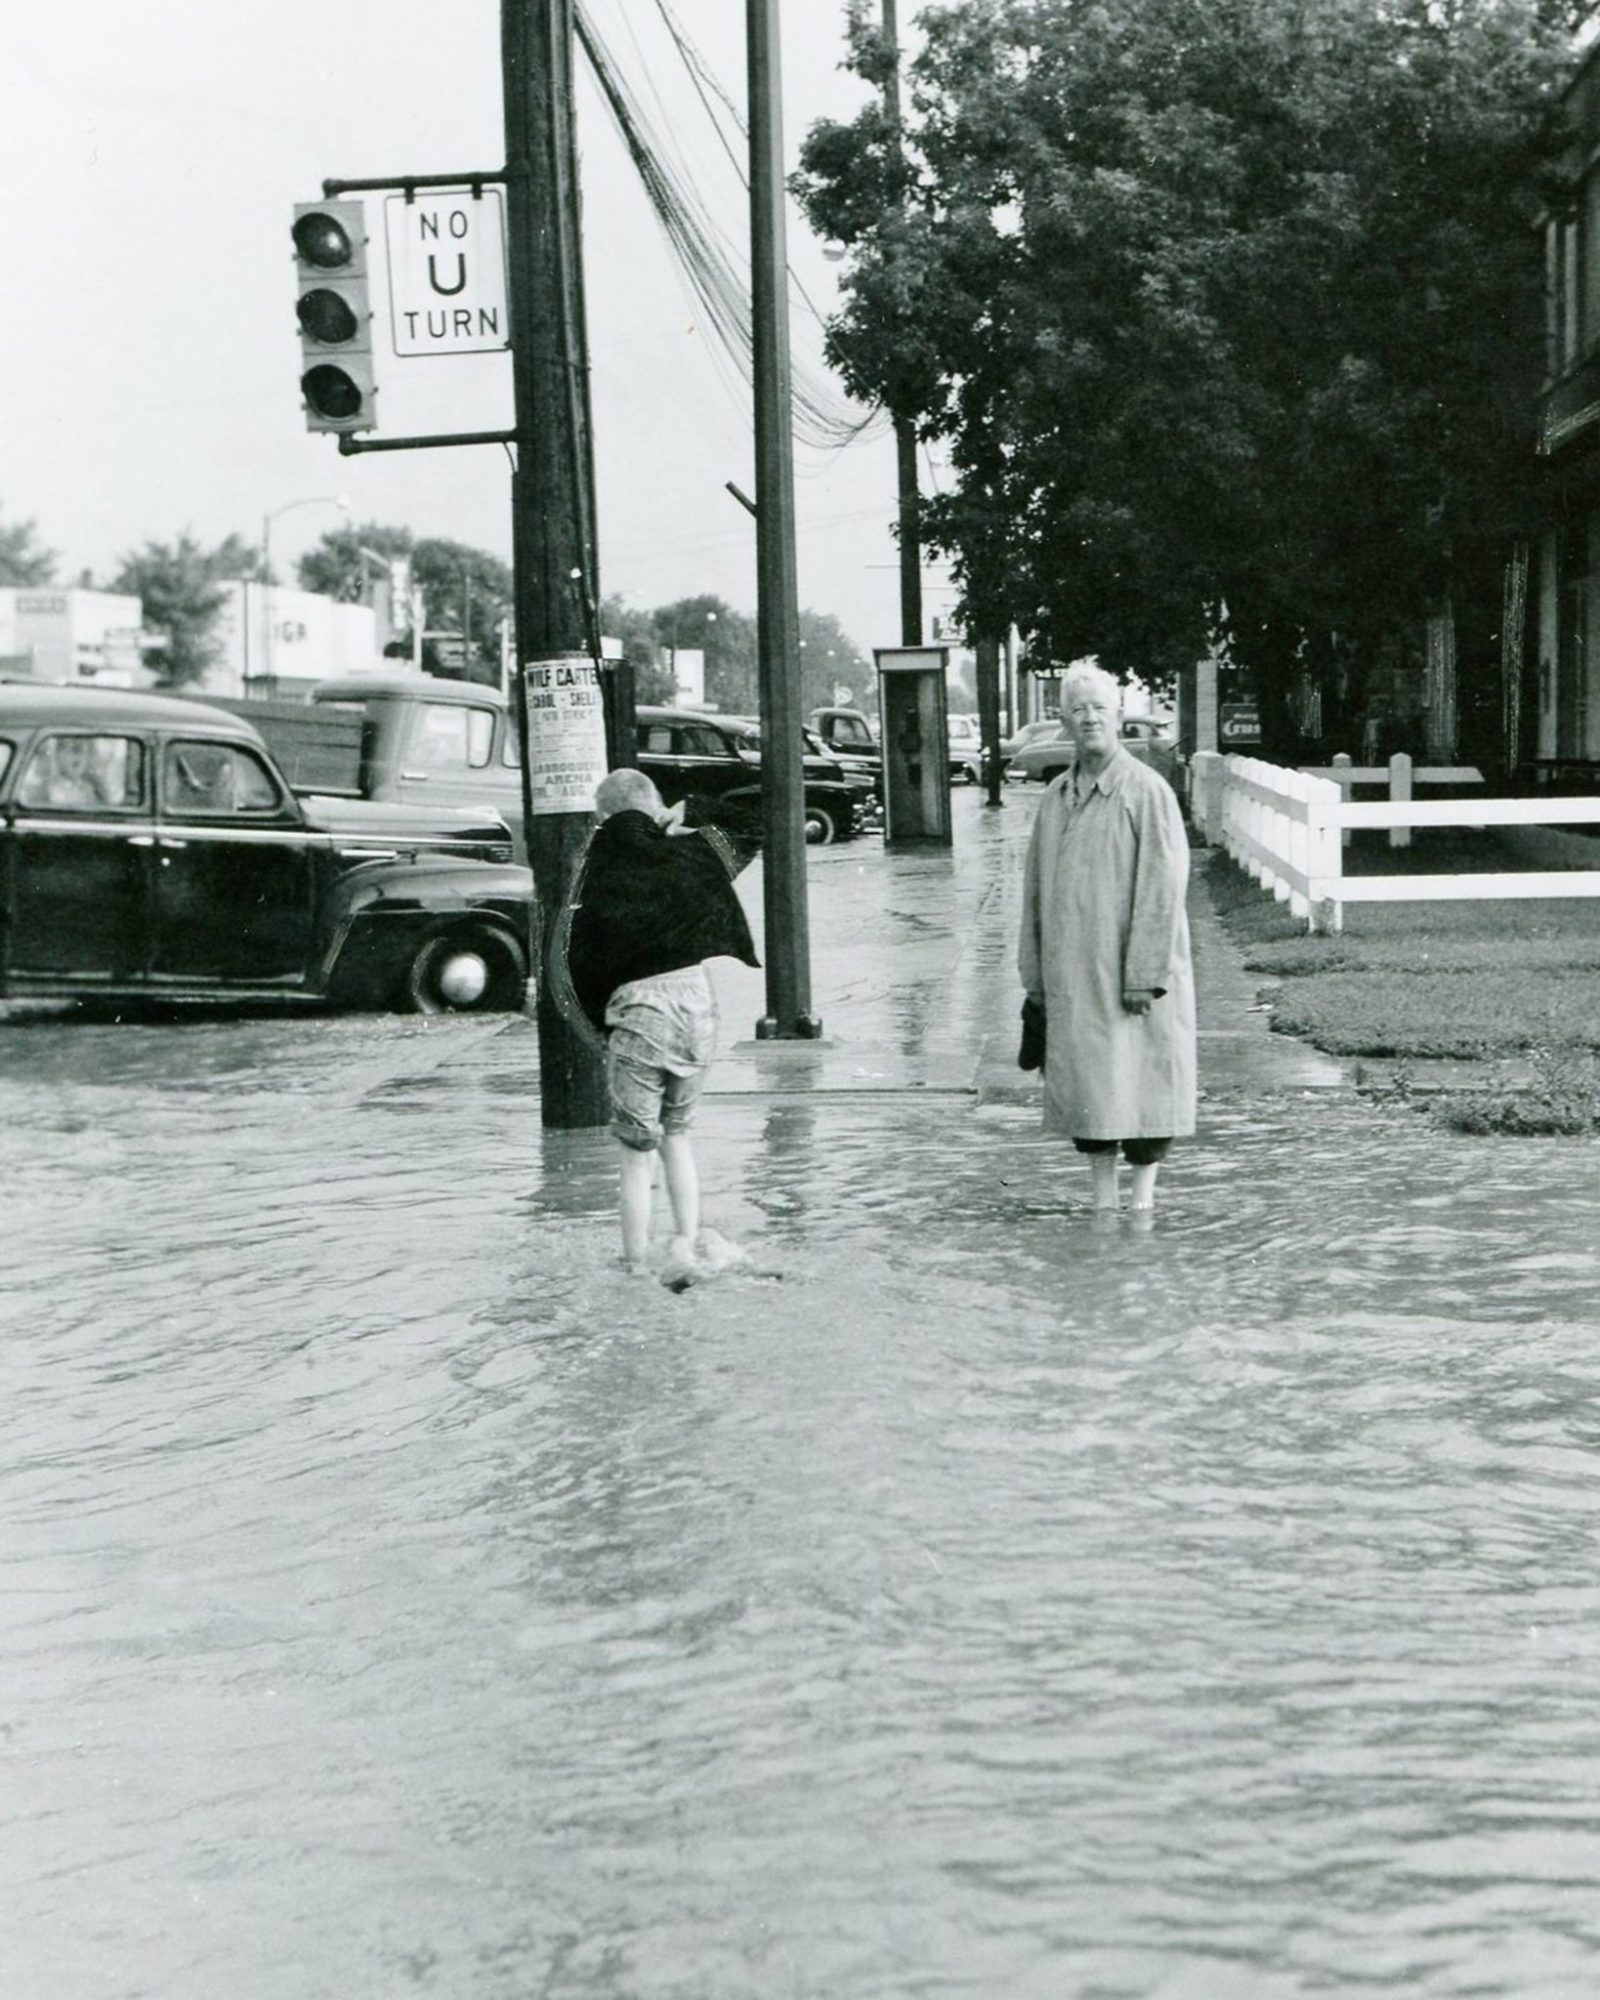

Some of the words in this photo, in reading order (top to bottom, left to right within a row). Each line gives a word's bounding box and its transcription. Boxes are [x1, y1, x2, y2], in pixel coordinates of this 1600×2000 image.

[419, 209, 469, 241] NO
[428, 252, 466, 296] U
[403, 307, 499, 340] TURN
[527, 668, 552, 689] WILF
[556, 667, 599, 687] CARTE
[544, 773, 592, 785] ARENA
